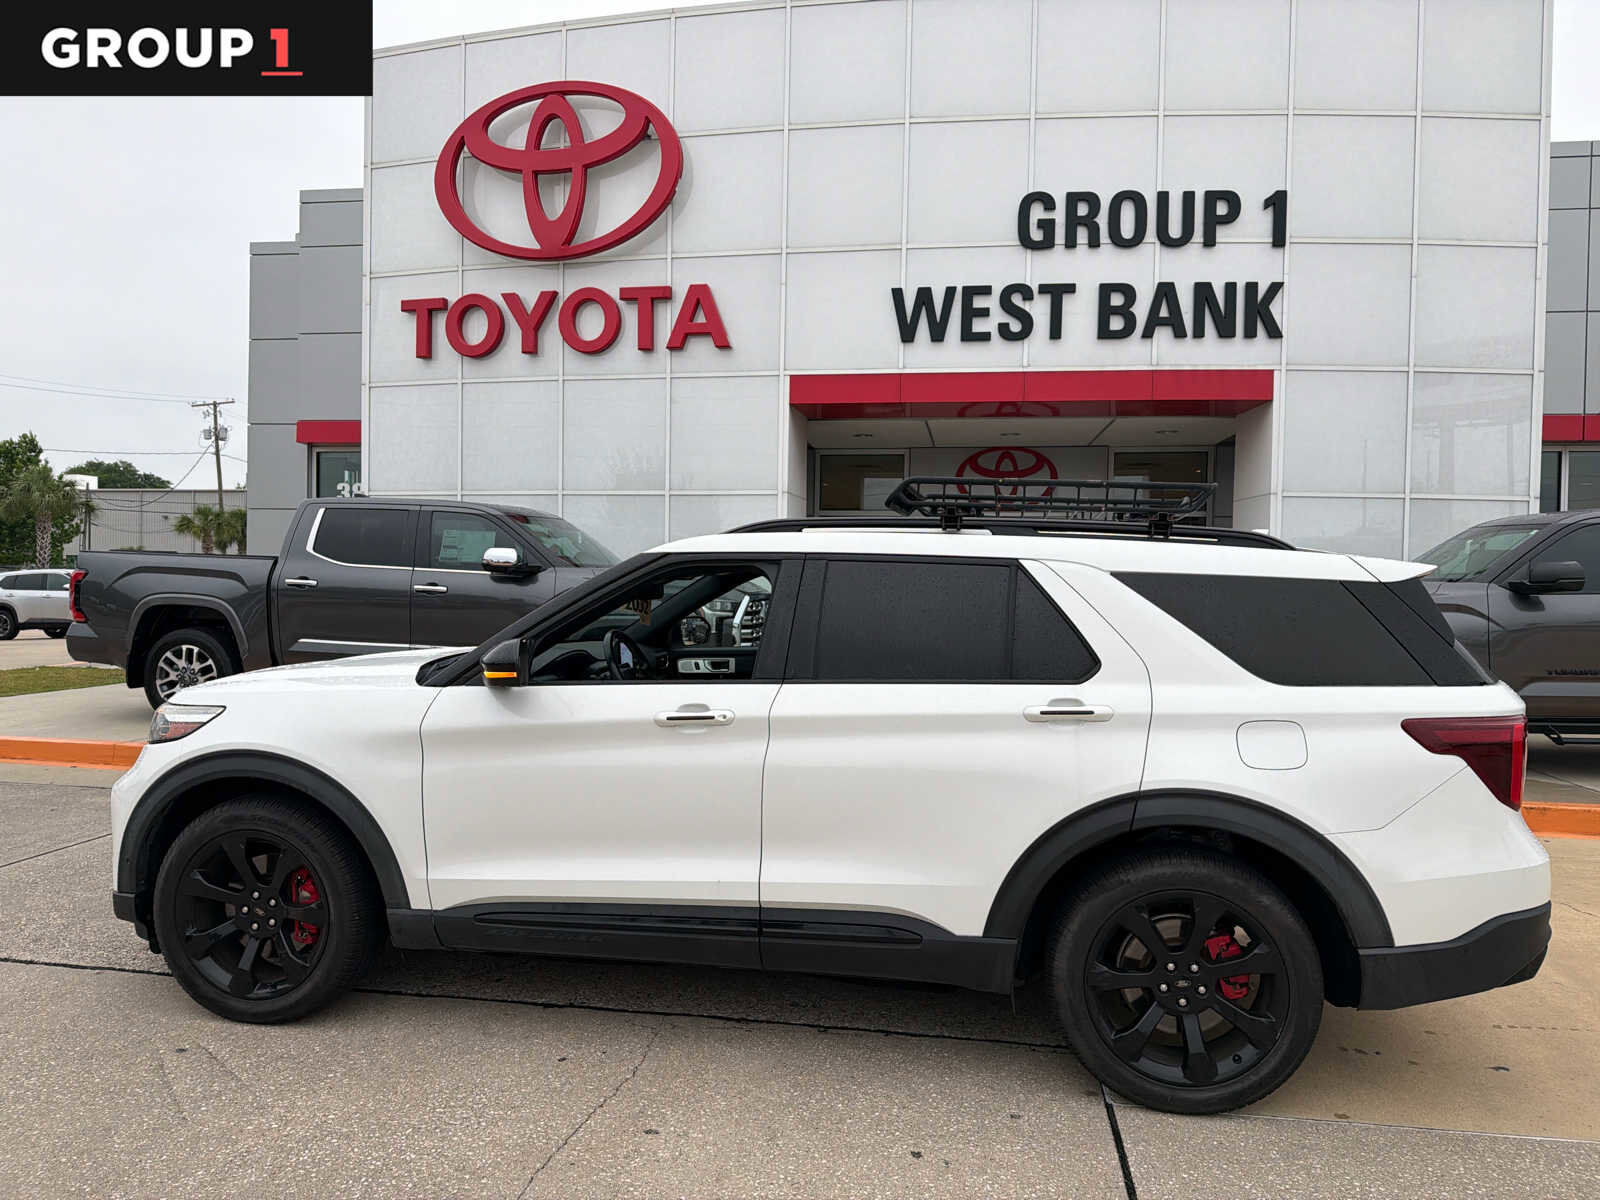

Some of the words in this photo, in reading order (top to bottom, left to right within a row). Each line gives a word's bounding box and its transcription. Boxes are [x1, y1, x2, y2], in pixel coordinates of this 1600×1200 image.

[1017, 189, 1242, 252] GROUP
[1263, 189, 1288, 249] 1
[400, 283, 732, 360] TOYOTA
[892, 283, 1077, 344] WEST
[1096, 281, 1285, 341] BANK
